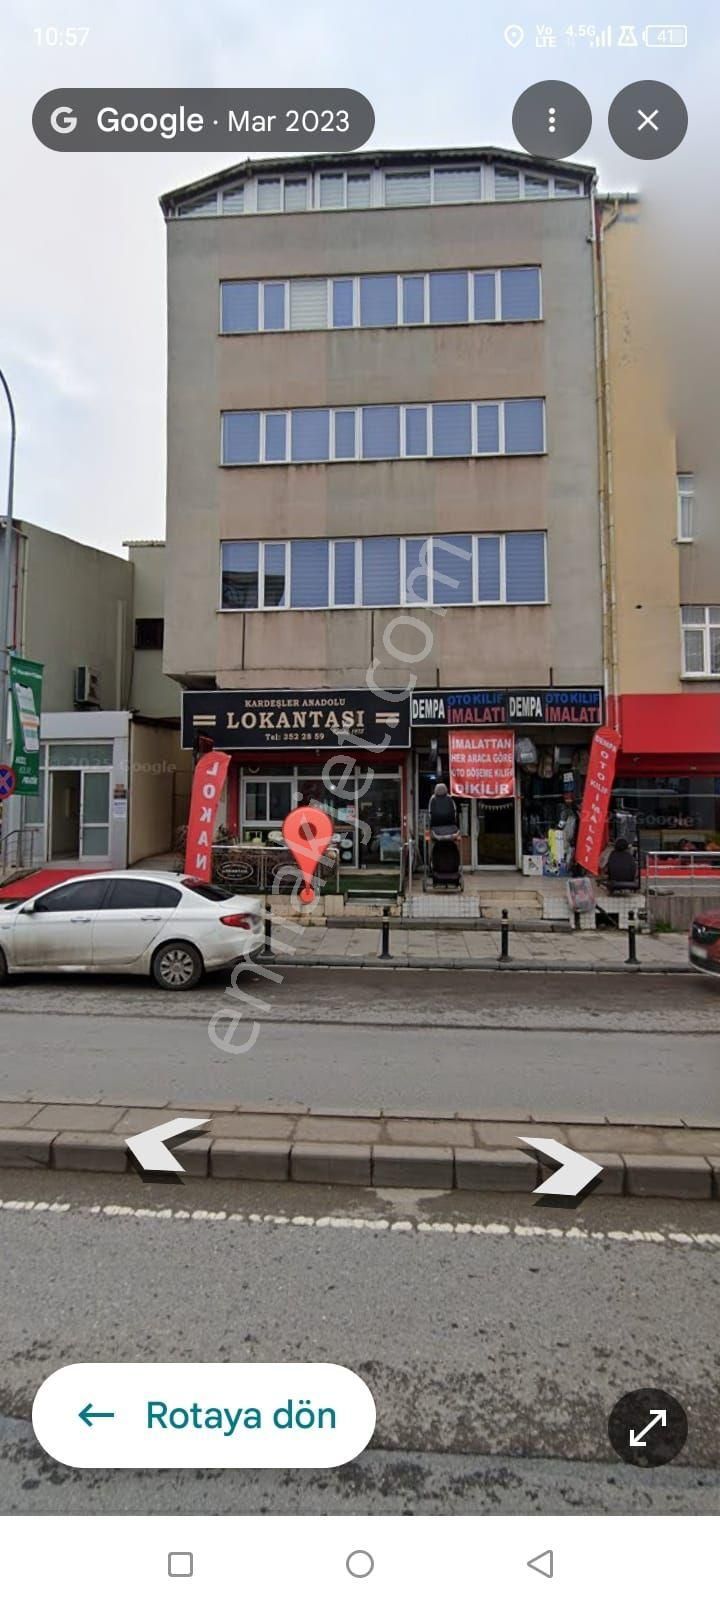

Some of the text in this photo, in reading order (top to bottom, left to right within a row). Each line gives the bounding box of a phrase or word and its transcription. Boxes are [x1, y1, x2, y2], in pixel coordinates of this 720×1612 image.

[244, 698, 346, 709] KARDEŞLER ANADOLU
[447, 695, 473, 706] OTO
[544, 693, 568, 704] OTO
[412, 698, 445, 719] DEMPA
[509, 696, 543, 717] DEMPA
[226, 710, 366, 729] LOKANTASI
[447, 706, 505, 724] İMALATI
[544, 706, 601, 723] İMALATI
[451, 736, 512, 750] İMALATTAN
[451, 753, 466, 763] HER
[454, 780, 510, 795] DİKİLİR
